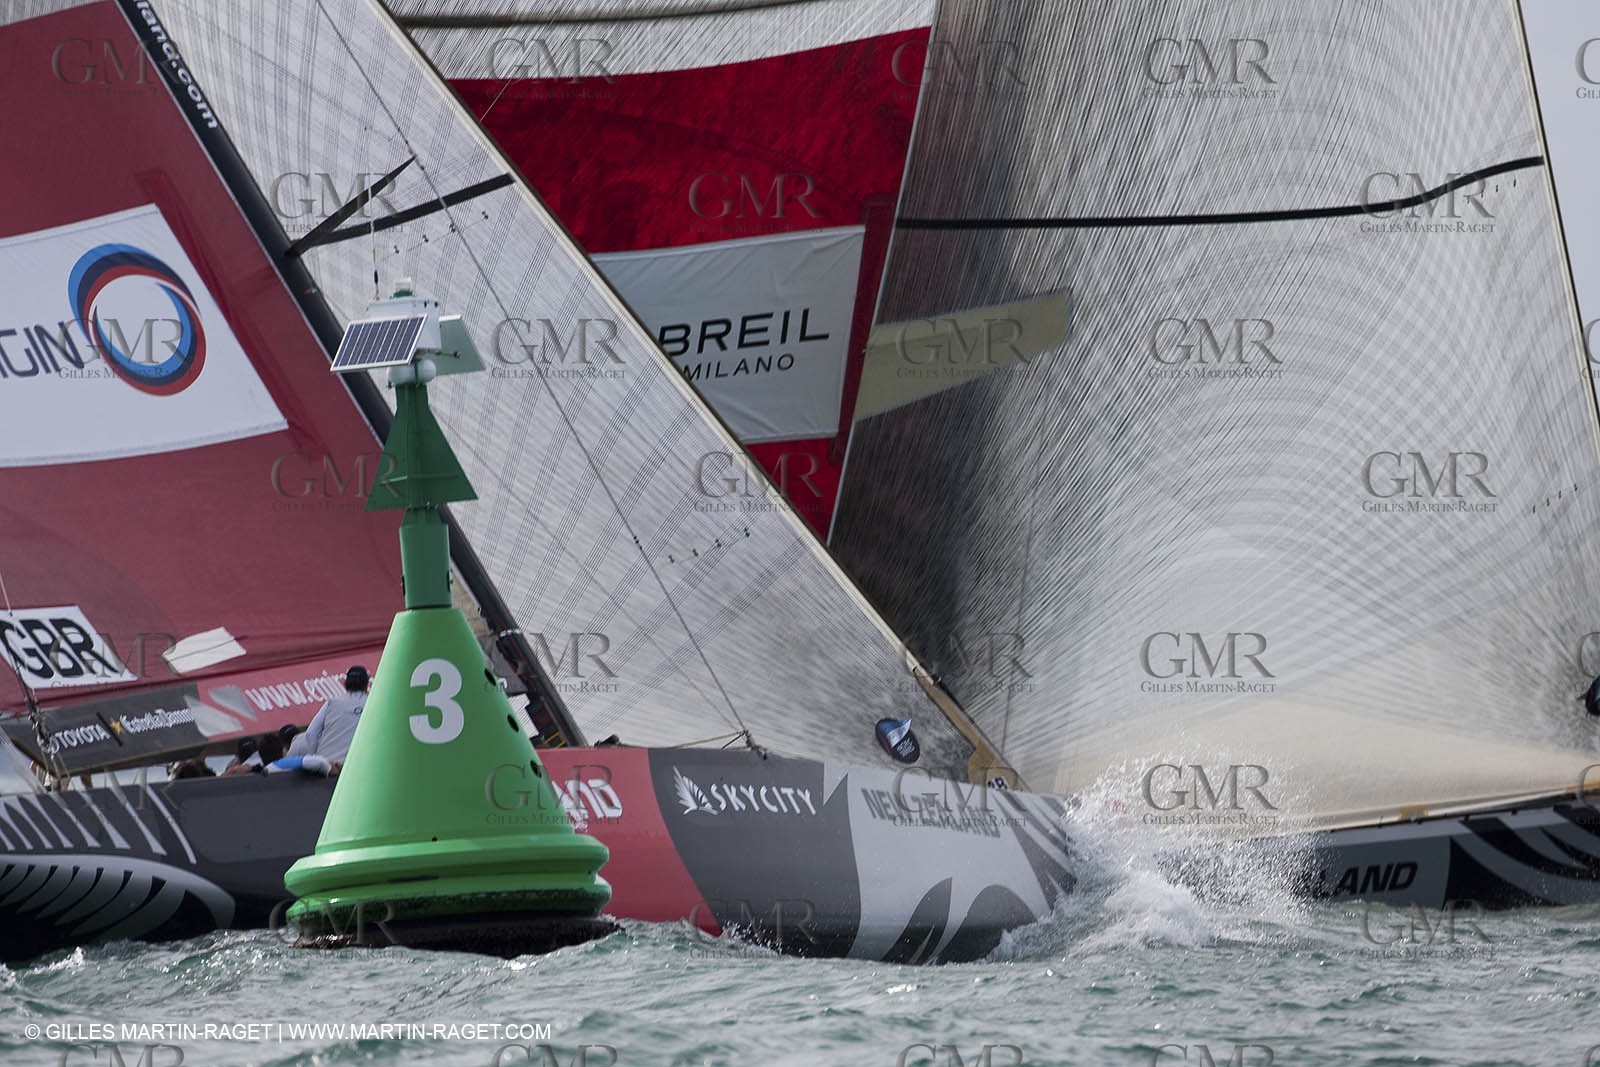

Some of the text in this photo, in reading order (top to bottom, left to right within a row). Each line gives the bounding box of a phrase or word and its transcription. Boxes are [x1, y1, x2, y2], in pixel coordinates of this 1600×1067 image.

[0, 321, 84, 379] GIN
[658, 308, 830, 357] BREIL
[683, 354, 795, 381] MILANO
[0, 618, 118, 678] GBR
[410, 658, 464, 744] 3
[55, 724, 111, 749] TOYOTA
[710, 783, 816, 815] SKYCITY
